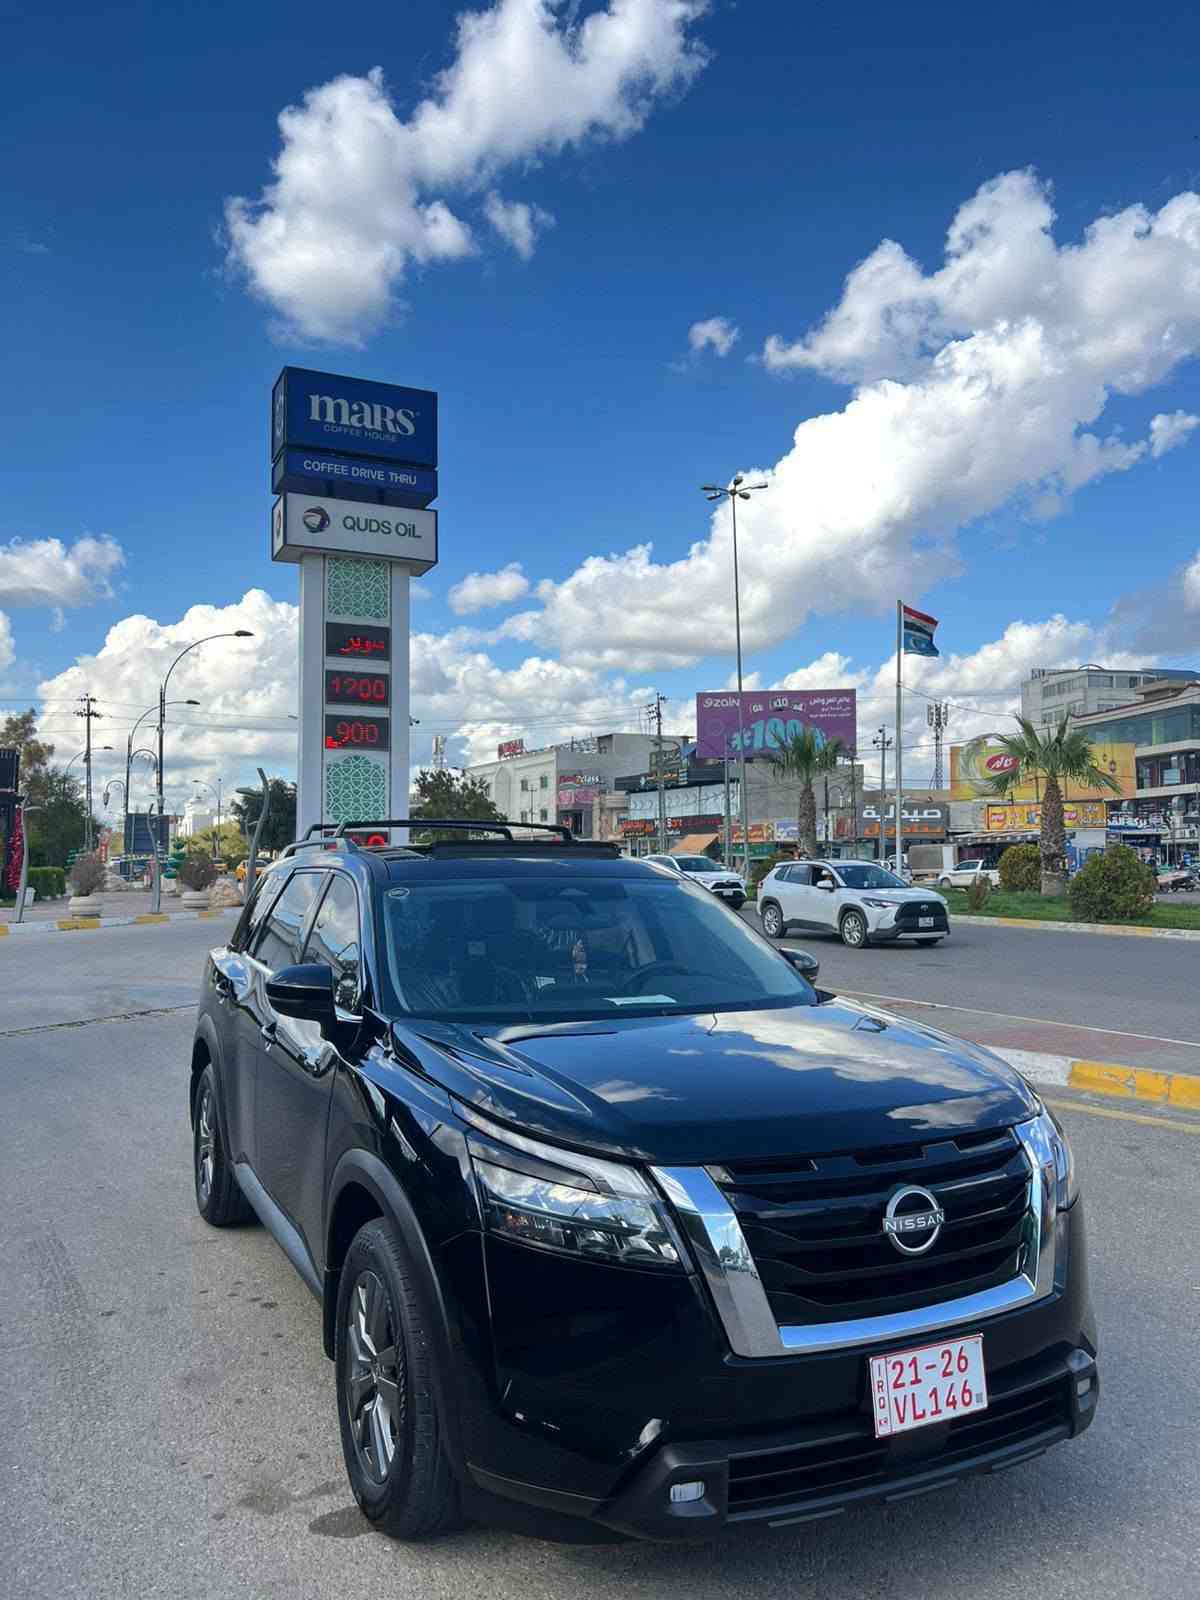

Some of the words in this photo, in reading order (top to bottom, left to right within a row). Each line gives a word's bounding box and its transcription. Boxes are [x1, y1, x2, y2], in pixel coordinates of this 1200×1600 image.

[323, 423, 361, 438] COFFEE
[303, 459, 349, 475] COFFEE
[351, 466, 385, 481] DRIVE
[389, 471, 417, 486] THRU
[342, 515, 392, 536] QUDS
[884, 1213, 945, 1232] NISSAN
[891, 1345, 969, 1389] 21-26
[893, 1378, 974, 1425] VL146
